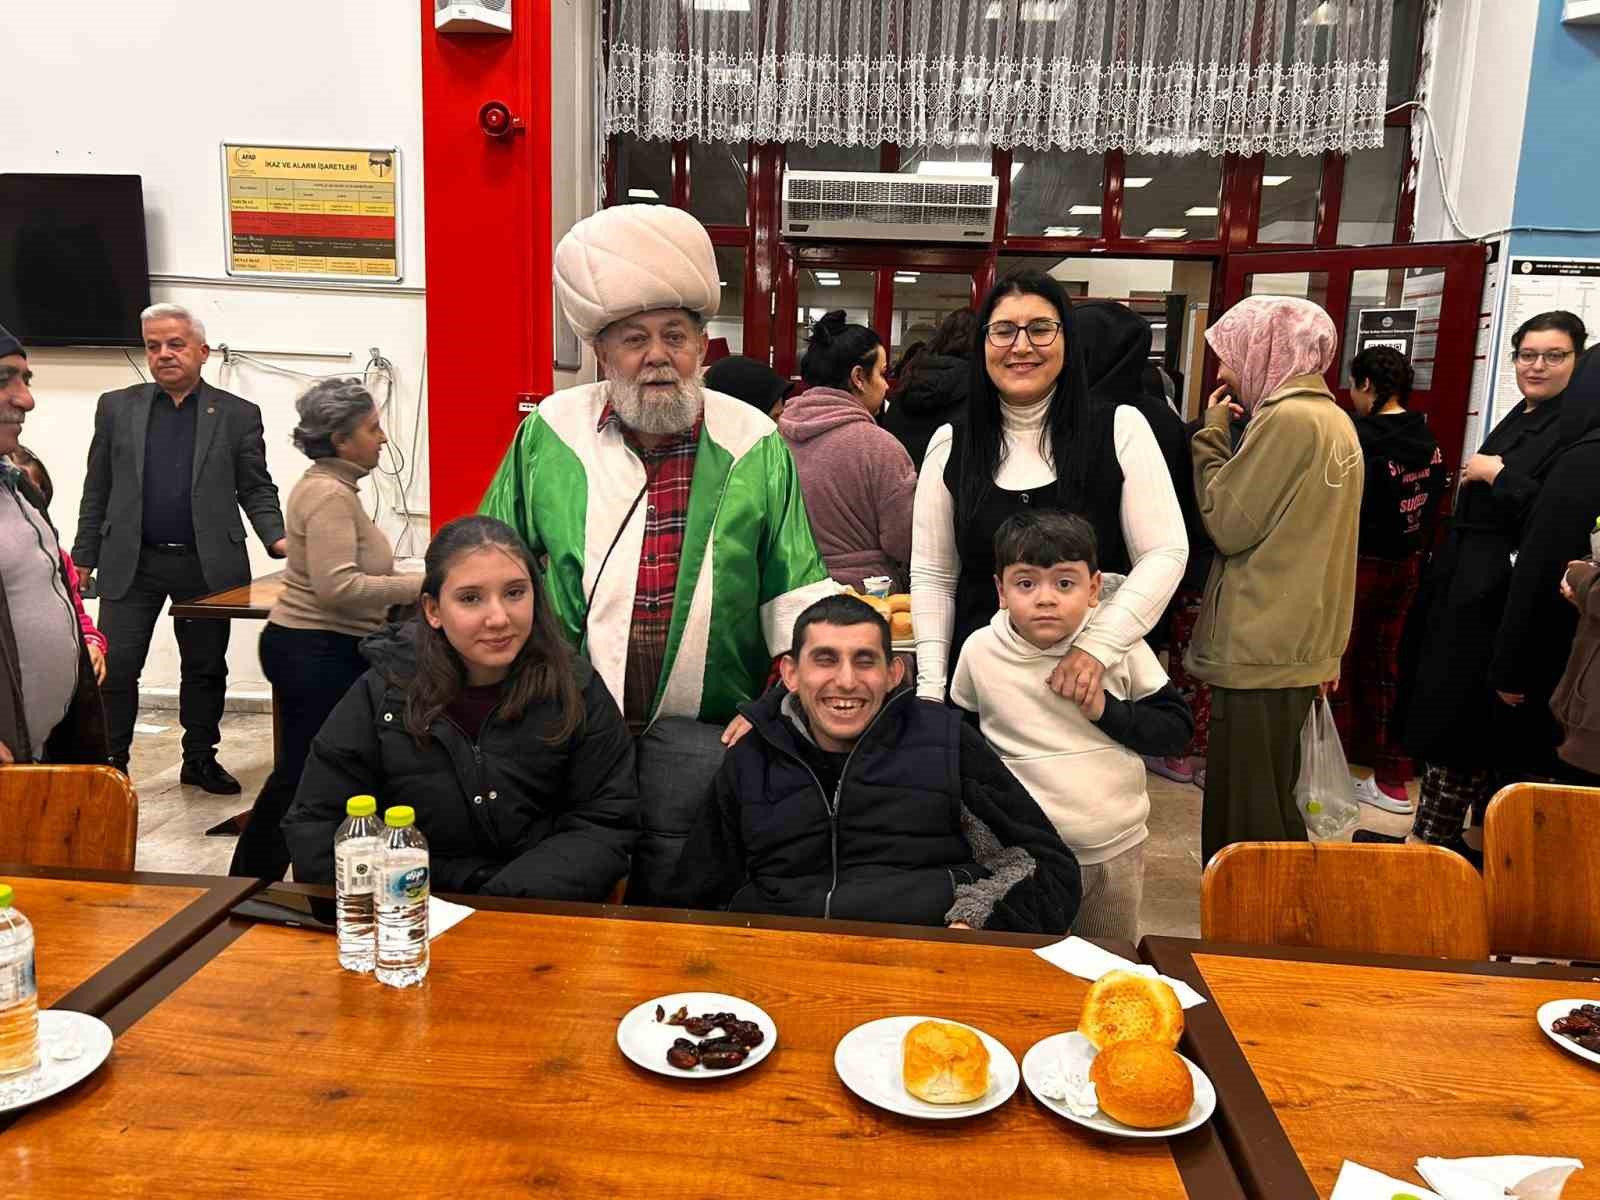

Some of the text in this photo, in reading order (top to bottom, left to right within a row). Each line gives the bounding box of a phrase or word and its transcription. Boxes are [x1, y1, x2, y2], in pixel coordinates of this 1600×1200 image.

[264, 160, 358, 172] İKAZ VE ALARM İŞARETLERİ
